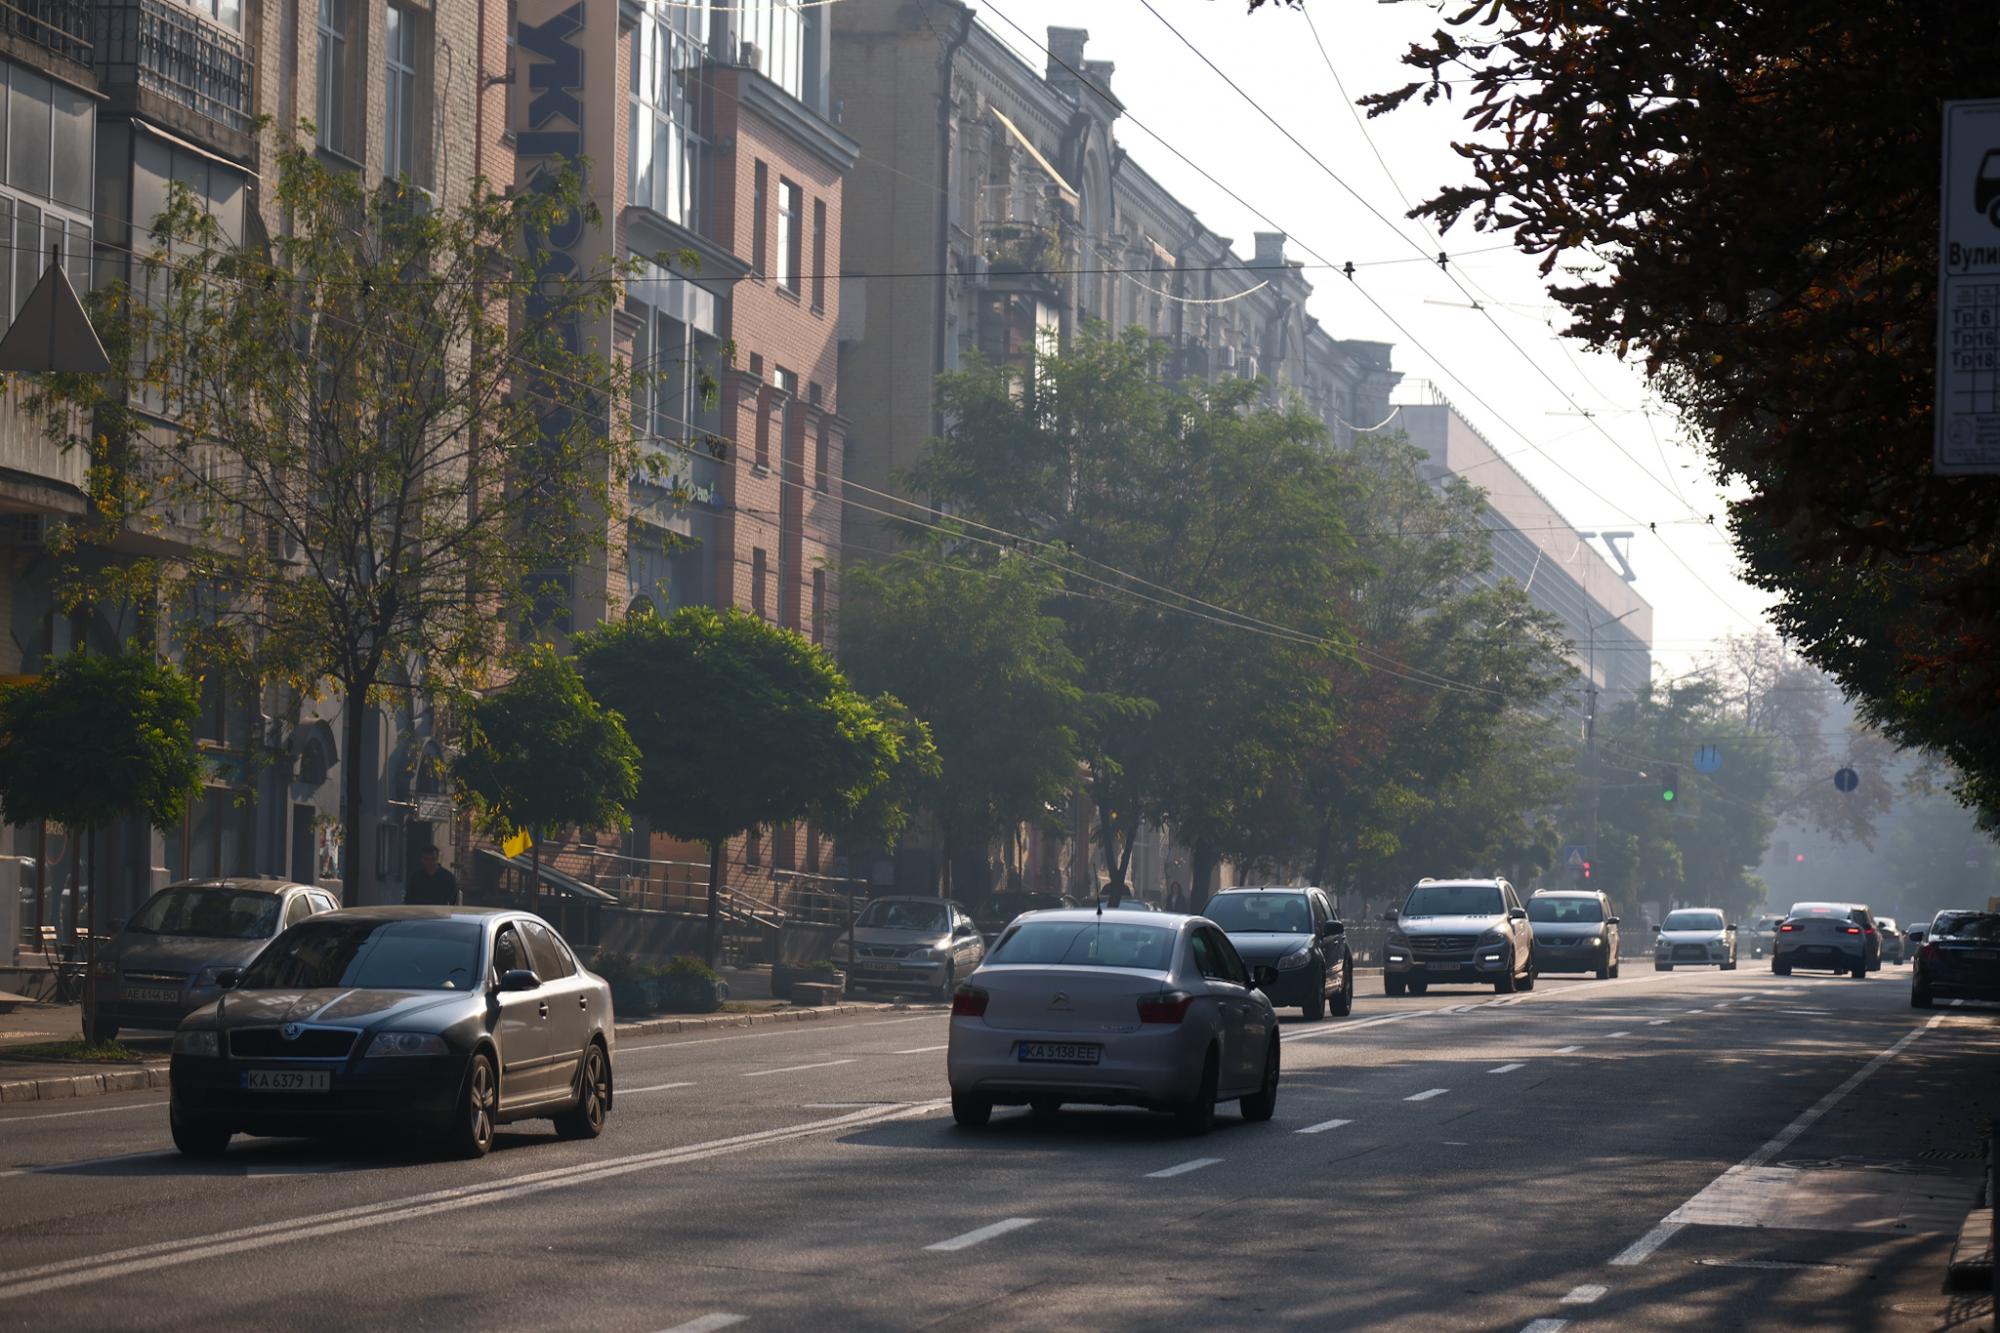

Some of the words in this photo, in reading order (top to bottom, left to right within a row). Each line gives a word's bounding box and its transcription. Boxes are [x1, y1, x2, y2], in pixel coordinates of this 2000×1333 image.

[1949, 241, 2000, 272] Вули
[1952, 309, 1974, 326] Тр
[1981, 309, 1990, 325] 6
[1952, 330, 1973, 347] Тр
[1975, 331, 1994, 346] 16
[1951, 351, 1973, 368] Тр
[1975, 352, 1994, 367] 18
[1027, 1044, 1044, 1057] KA
[1047, 1046, 1075, 1058] 5138
[1078, 1047, 1096, 1059] EE
[249, 1073, 269, 1088] KA
[272, 1073, 304, 1088] 6379
